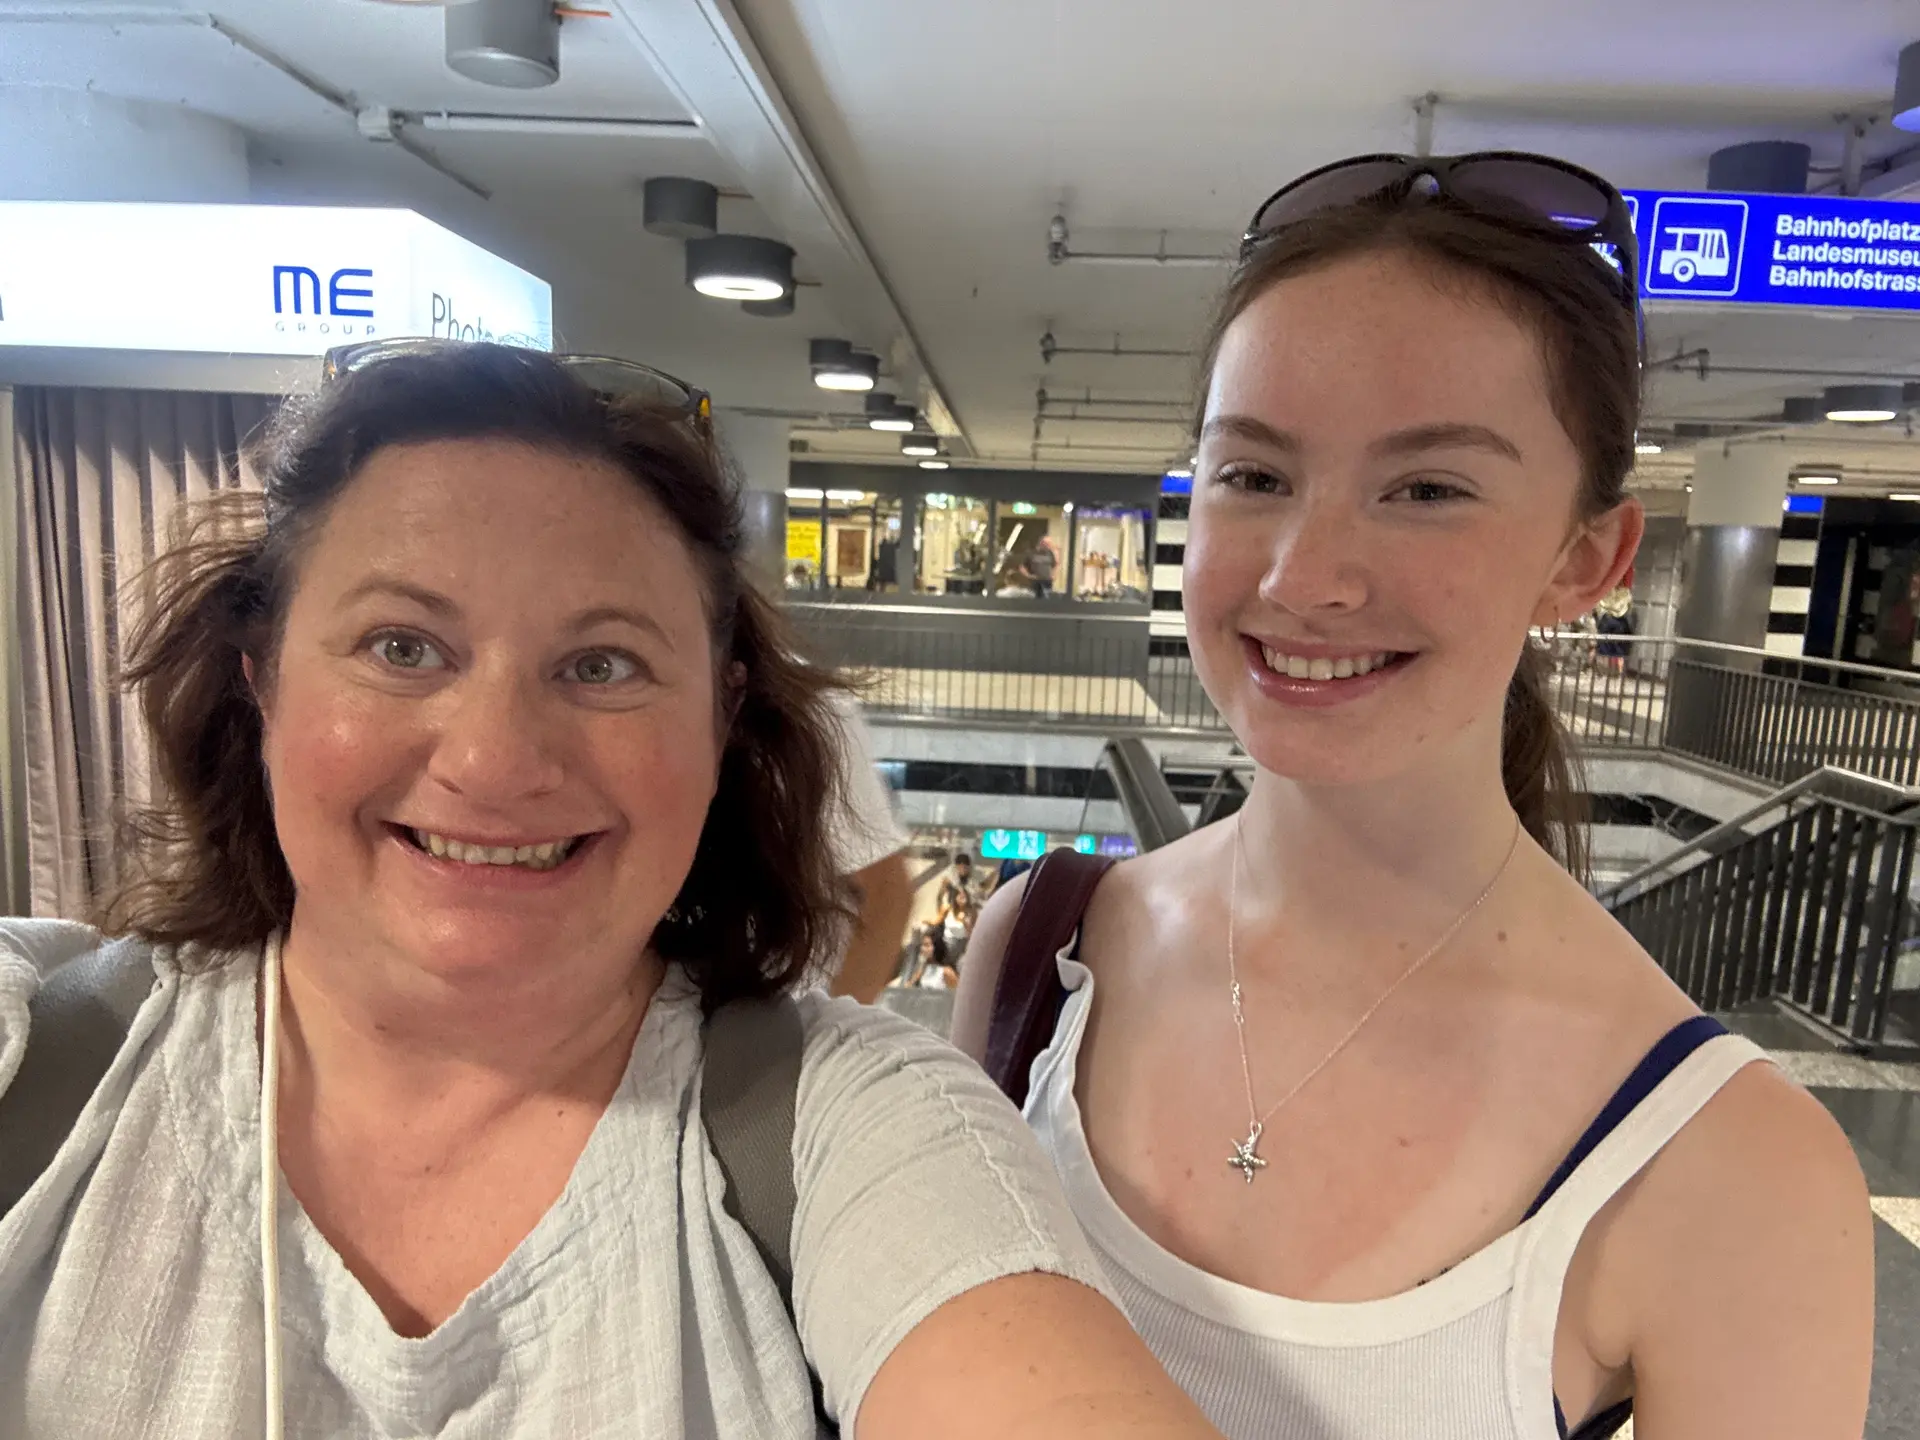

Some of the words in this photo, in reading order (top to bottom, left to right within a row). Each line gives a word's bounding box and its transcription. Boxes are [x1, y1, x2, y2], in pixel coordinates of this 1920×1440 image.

[1776, 213, 1920, 243] Bahnhofplatz
[273, 265, 374, 317] ME
[1769, 264, 1920, 292] Bahnhofstras
[275, 321, 375, 335] GROUP
